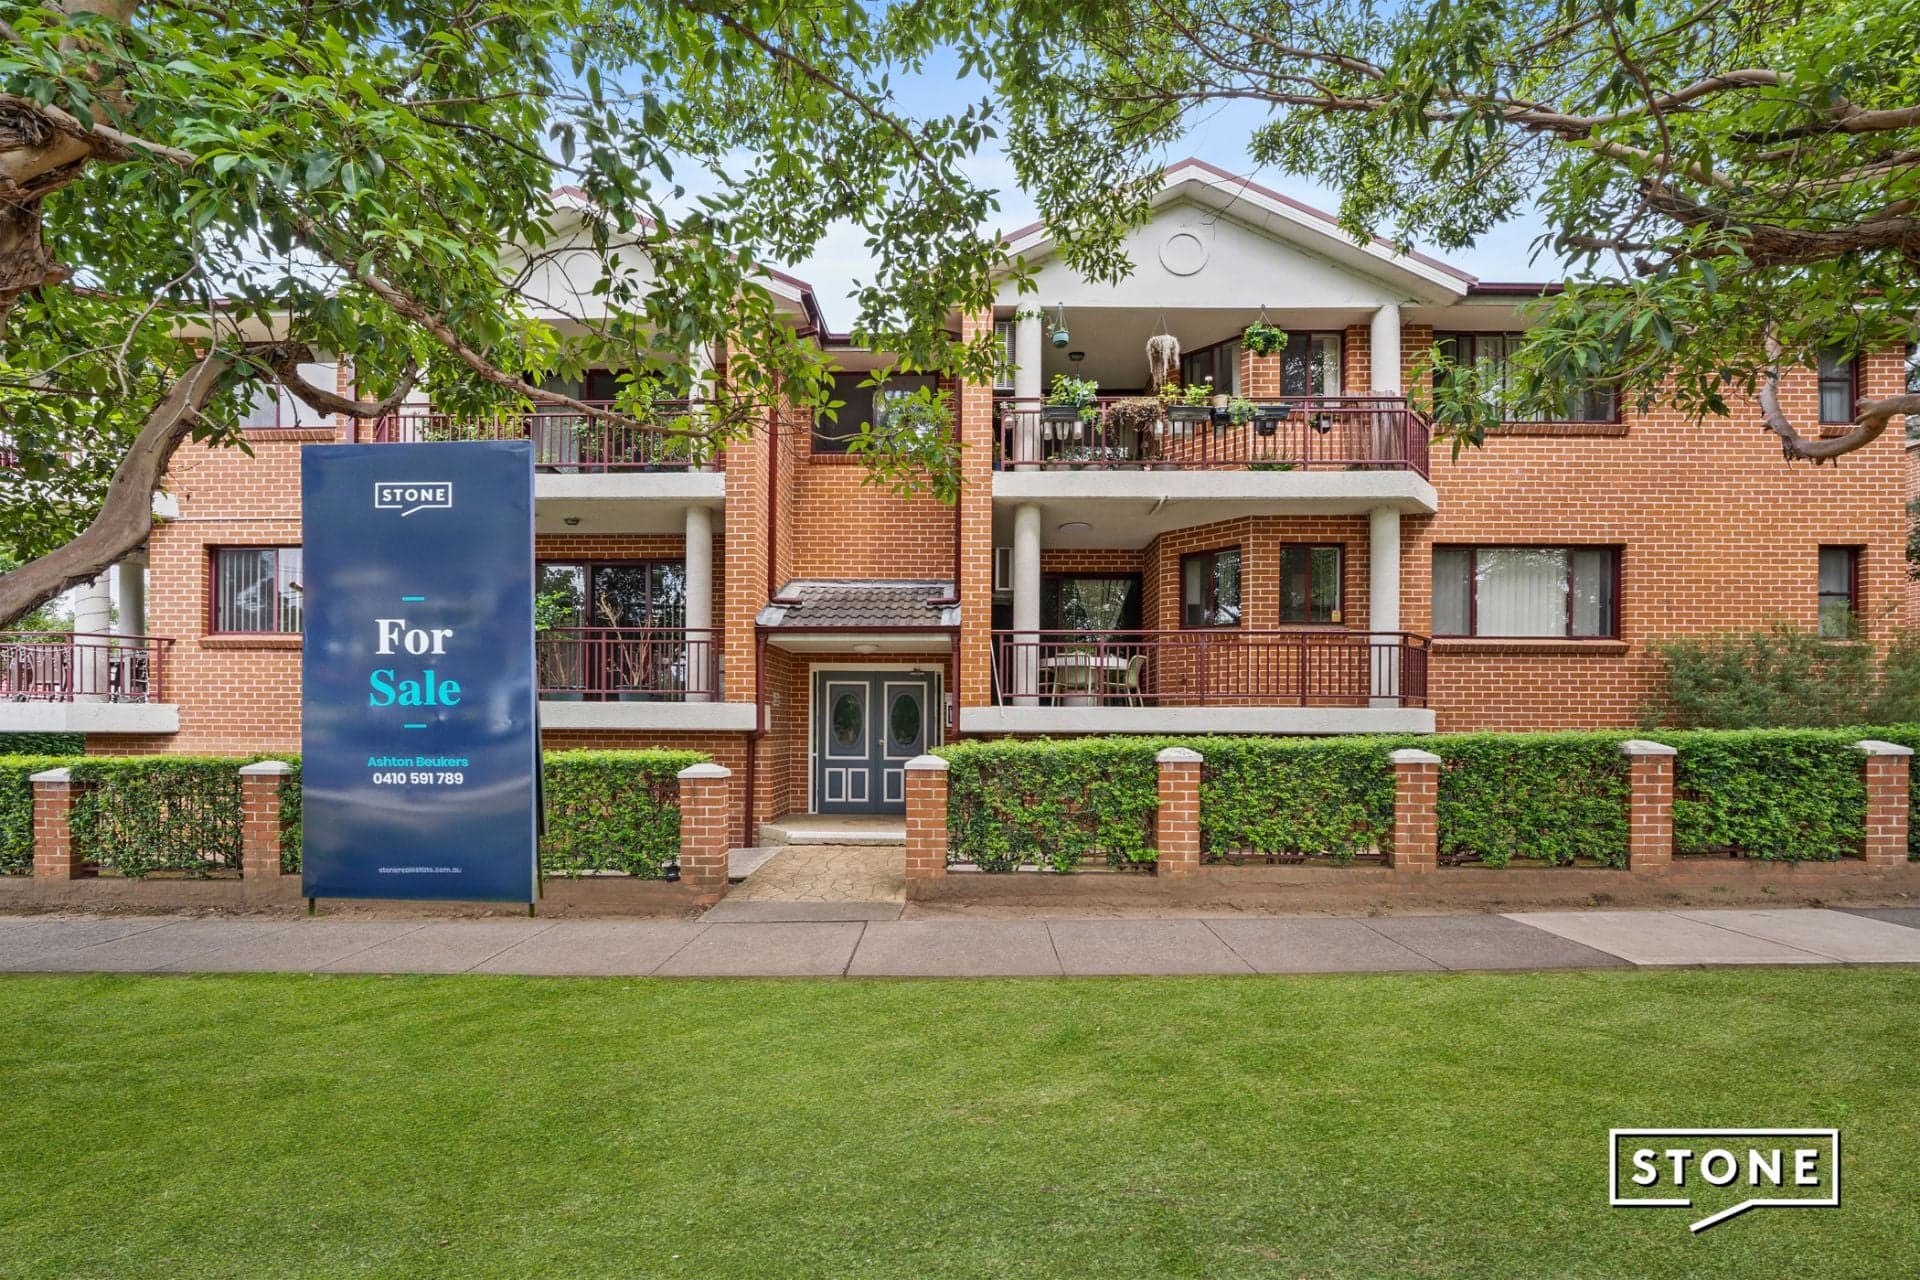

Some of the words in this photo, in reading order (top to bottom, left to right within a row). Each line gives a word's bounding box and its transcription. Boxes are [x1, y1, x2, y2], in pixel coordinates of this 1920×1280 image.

[382, 489, 445, 501] STONE
[374, 618, 454, 655] For
[369, 669, 461, 706] Sale
[367, 756, 414, 767] Ashton
[415, 756, 469, 767] Beukers
[373, 772, 406, 785] 0410
[410, 772, 434, 785] 591
[436, 772, 464, 785] 789
